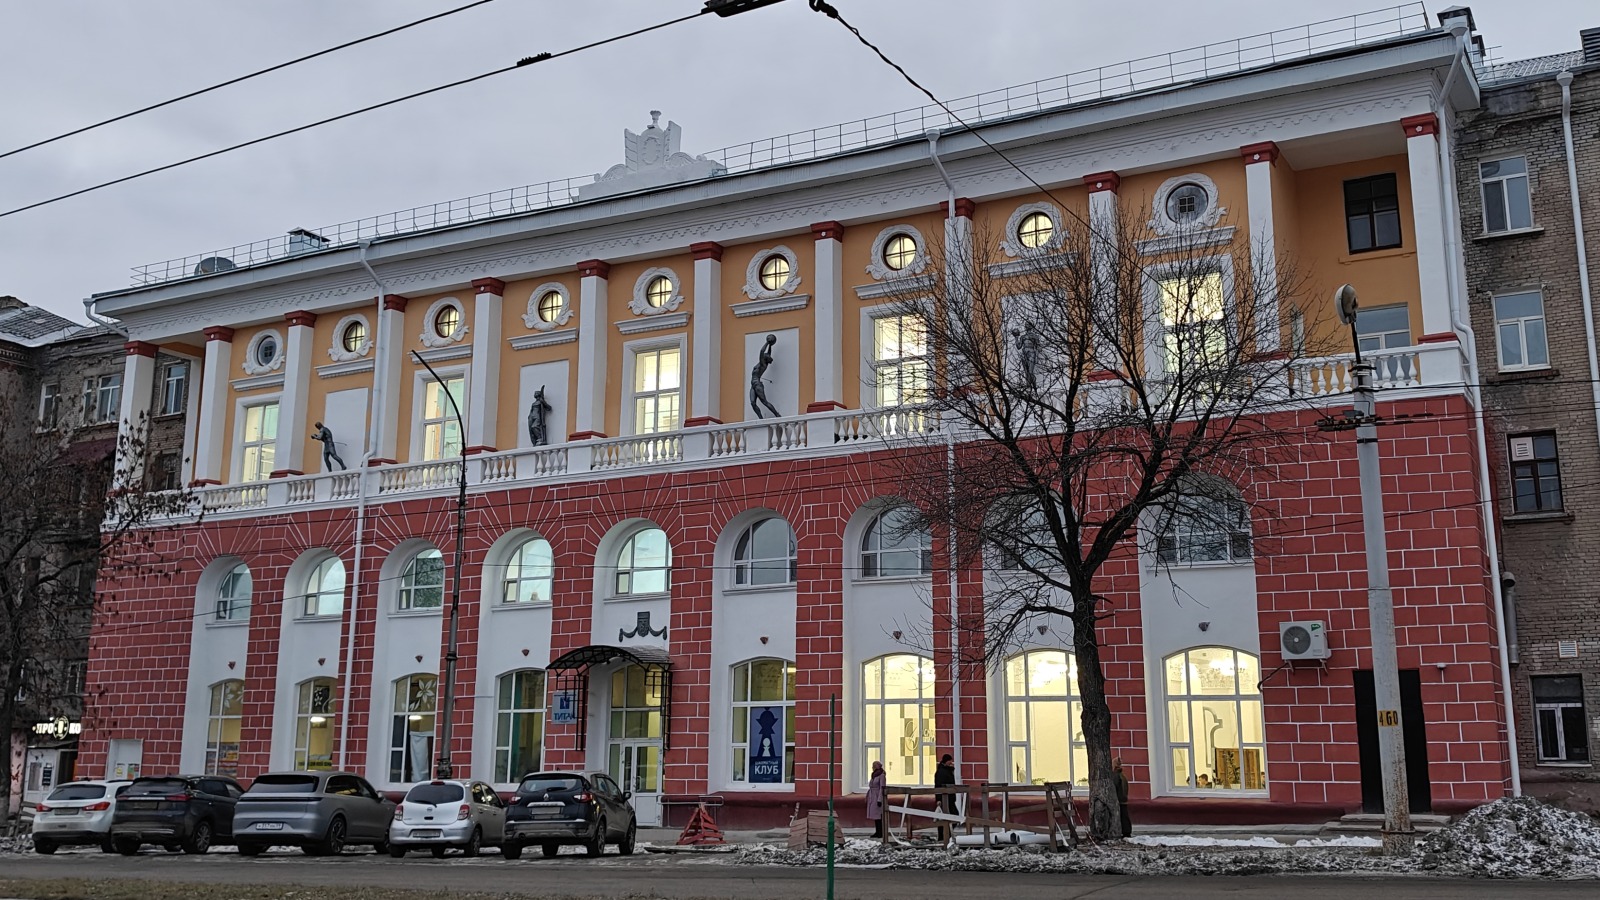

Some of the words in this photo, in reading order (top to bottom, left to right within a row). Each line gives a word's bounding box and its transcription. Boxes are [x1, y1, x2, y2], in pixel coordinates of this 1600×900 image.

[553, 712, 576, 721] ТИТА
[1379, 710, 1399, 726] 460
[36, 722, 54, 734] ПРО
[754, 765, 779, 775] КЛУБ
